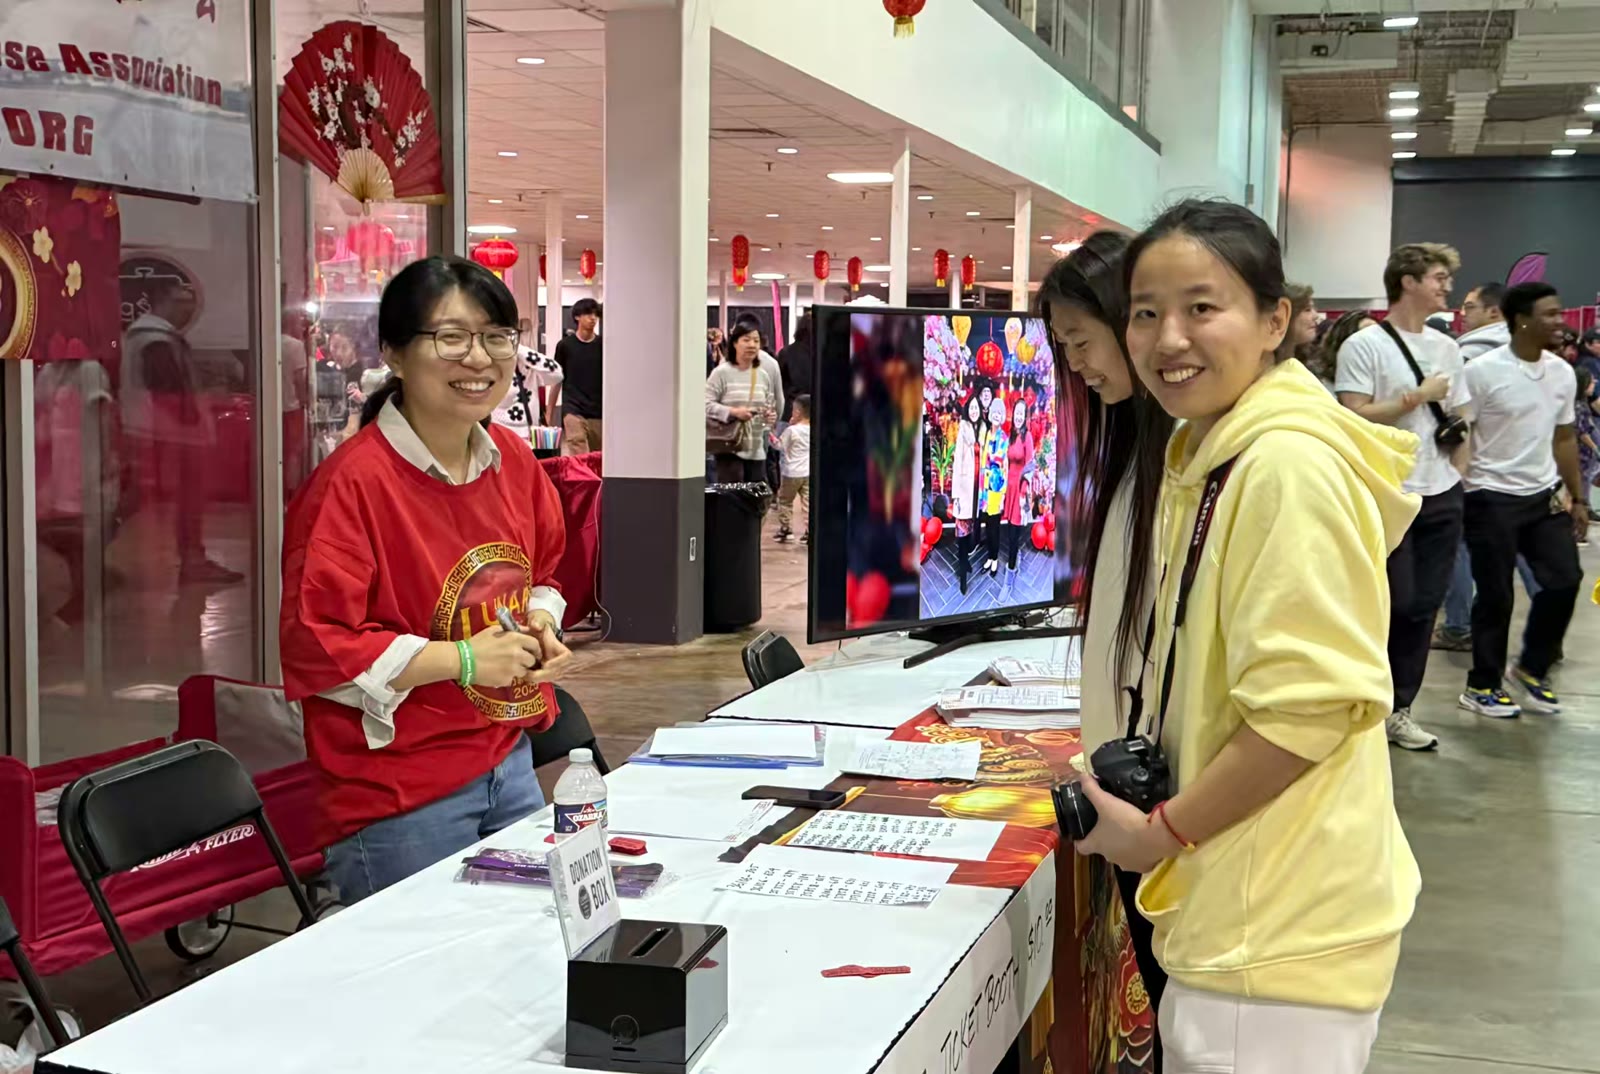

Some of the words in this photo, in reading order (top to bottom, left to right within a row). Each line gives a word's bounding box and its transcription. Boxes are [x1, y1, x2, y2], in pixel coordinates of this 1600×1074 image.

[0, 41, 50, 72] se
[58, 43, 222, 107] Association
[203, 824, 255, 851] FLYER
[569, 847, 603, 885] DONATION
[590, 879, 611, 910] BOX
[940, 992, 983, 1074] TICKET
[984, 956, 1020, 1028] BOOTH
